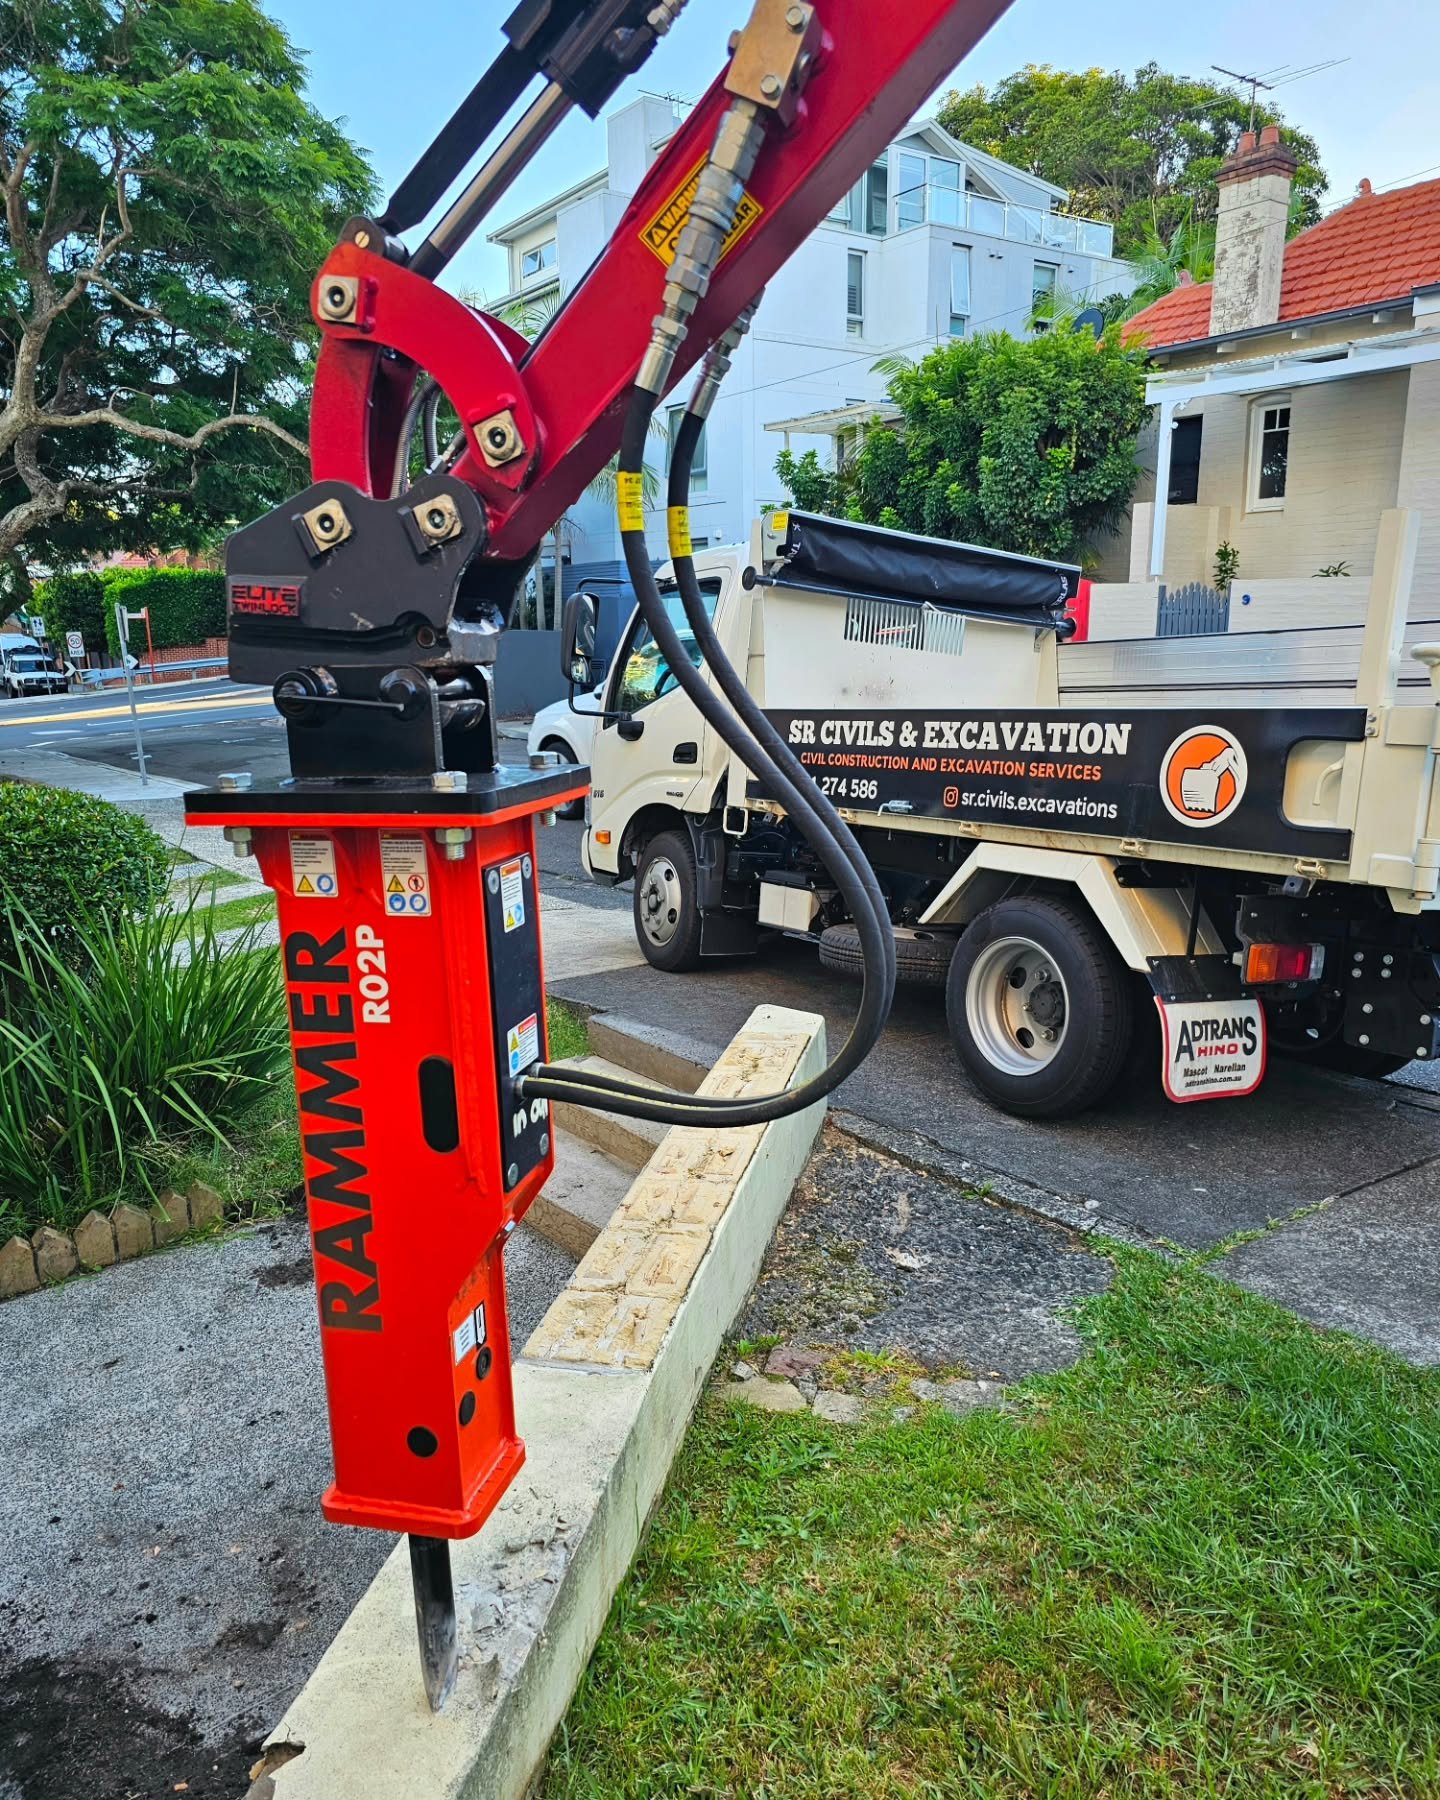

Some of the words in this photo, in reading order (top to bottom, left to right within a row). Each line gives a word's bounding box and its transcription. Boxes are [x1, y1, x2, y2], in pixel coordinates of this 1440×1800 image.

[231, 585, 297, 602] ELITE
[1241, 594, 1251, 606] 9
[232, 601, 297, 615] TWINLOCK
[70, 637, 80, 645] 50
[788, 719, 816, 744] SR
[820, 719, 895, 747] CIVILS
[899, 720, 919, 748] &
[922, 721, 1132, 755] EXCAVATION
[800, 752, 826, 765] CIVIL
[828, 753, 909, 770] CONSTRUCTION
[911, 757, 937, 771] AND
[940, 758, 1026, 777] EXCAVATION
[1029, 762, 1102, 781] SERVICES
[821, 776, 847, 796] 274
[850, 778, 878, 799] 586
[961, 789, 1118, 819] sr.civils.excavations
[1175, 1016, 1257, 1063] ADTRANS
[1197, 1043, 1239, 1057] HINO
[1183, 1066, 1208, 1077] Mascot
[1214, 1062, 1246, 1074] Narellan
[1184, 1076, 1242, 1088] adtranshino.com.au
[284, 927, 383, 1332] RAMMER
